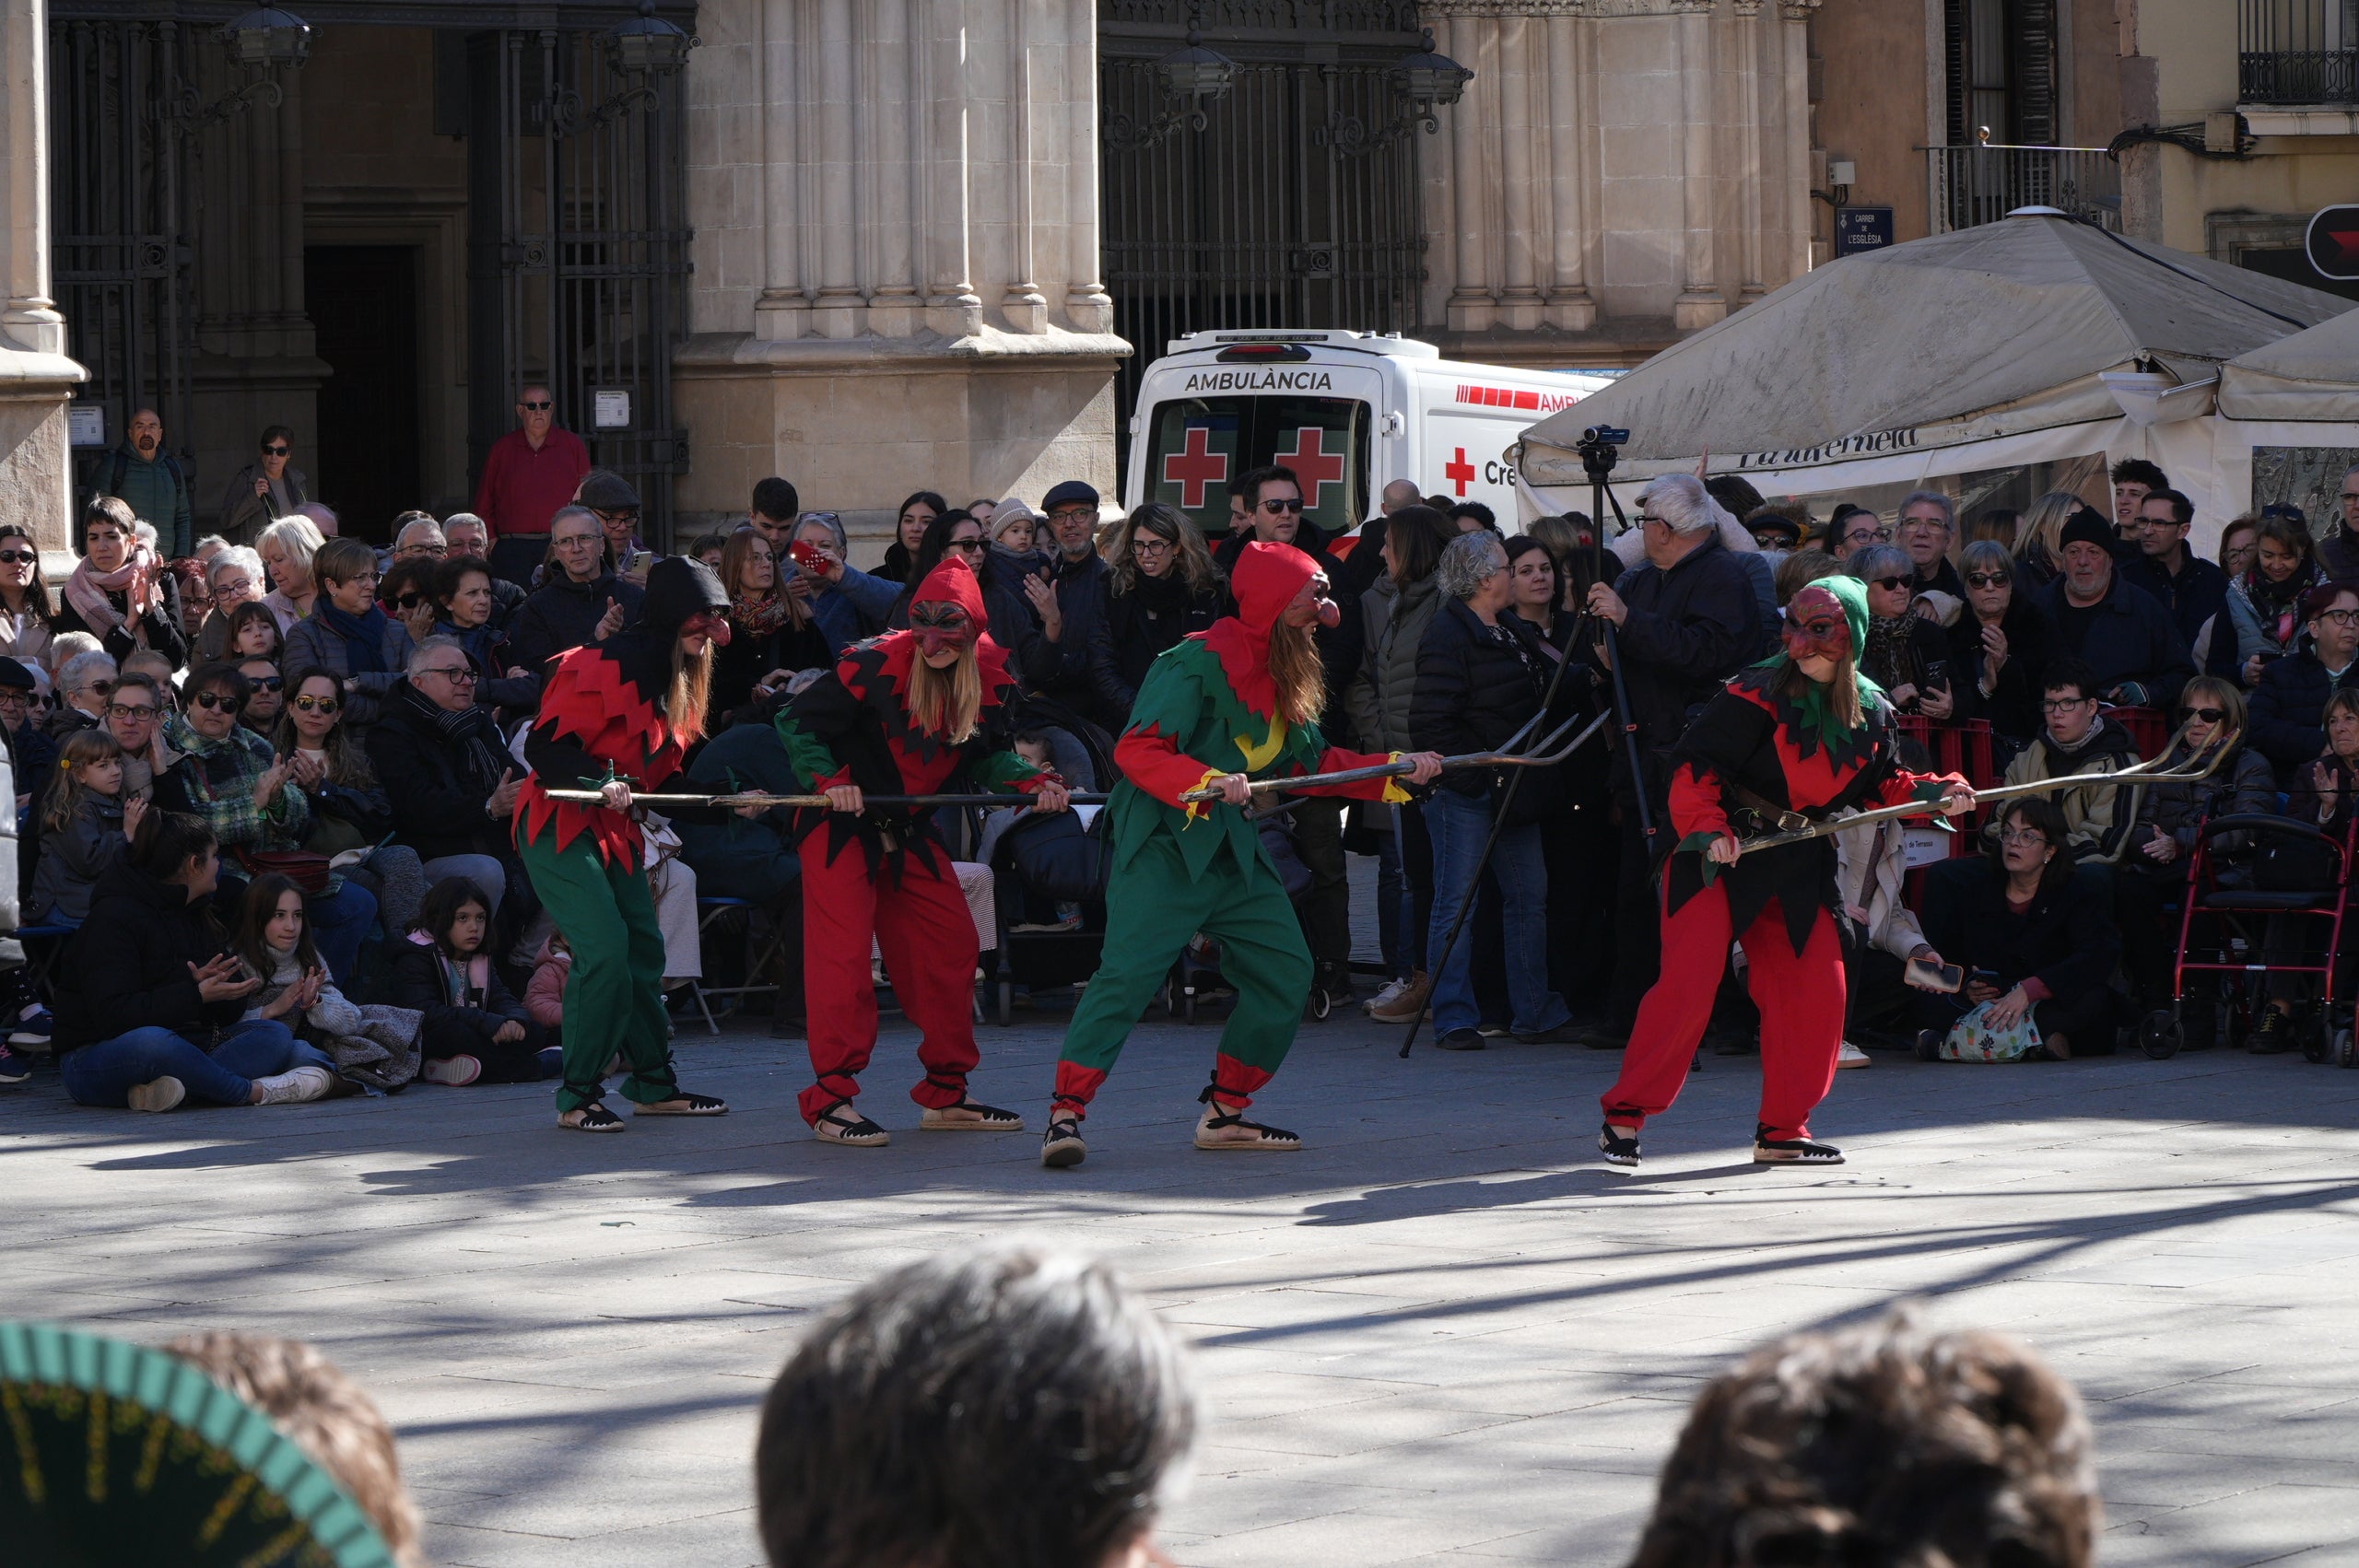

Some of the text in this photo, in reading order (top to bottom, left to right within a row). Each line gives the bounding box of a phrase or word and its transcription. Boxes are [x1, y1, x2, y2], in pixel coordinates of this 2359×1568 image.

[1855, 214, 1875, 223] CARRER
[1848, 232, 1883, 244] L'ESGLÉSIA
[1184, 368, 1332, 391] AMBULÀNCIA
[1541, 393, 1579, 413] AMB
